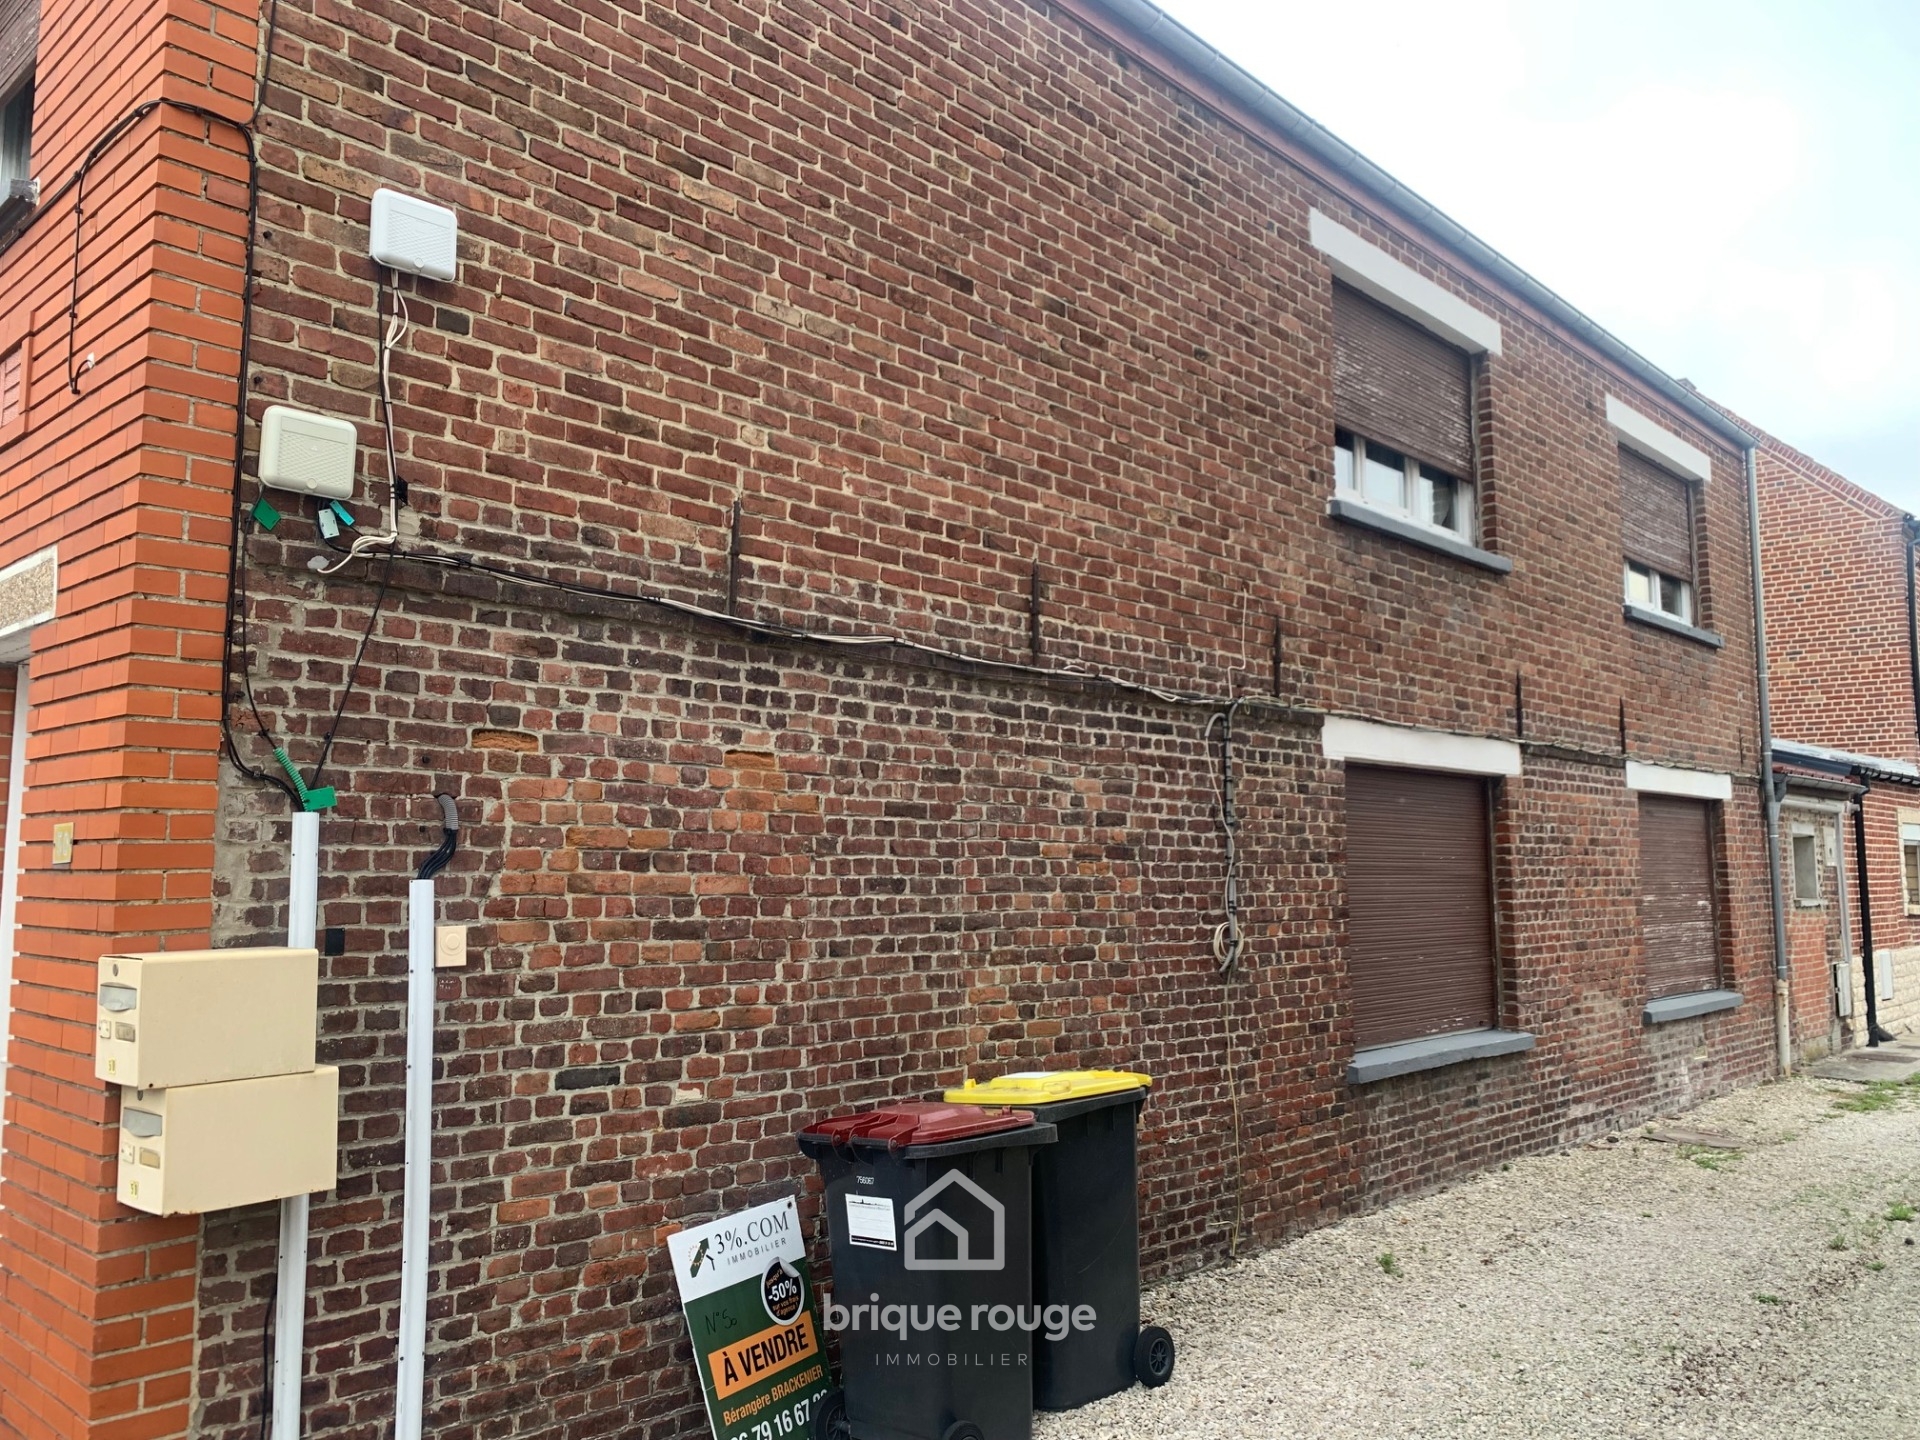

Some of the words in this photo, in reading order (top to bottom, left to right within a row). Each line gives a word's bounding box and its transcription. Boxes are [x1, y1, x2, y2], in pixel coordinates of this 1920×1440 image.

[714, 1211, 789, 1254] 3%.COM
[727, 1238, 787, 1266] IMMOBILIER
[768, 1278, 797, 1301] -50%
[722, 1351, 739, 1387] À
[738, 1323, 809, 1377] VENDRE
[723, 1395, 771, 1427] Bérangère
[771, 1364, 823, 1402] BRACKENIER
[773, 1409, 793, 1437] 16
[793, 1398, 811, 1427] 67
